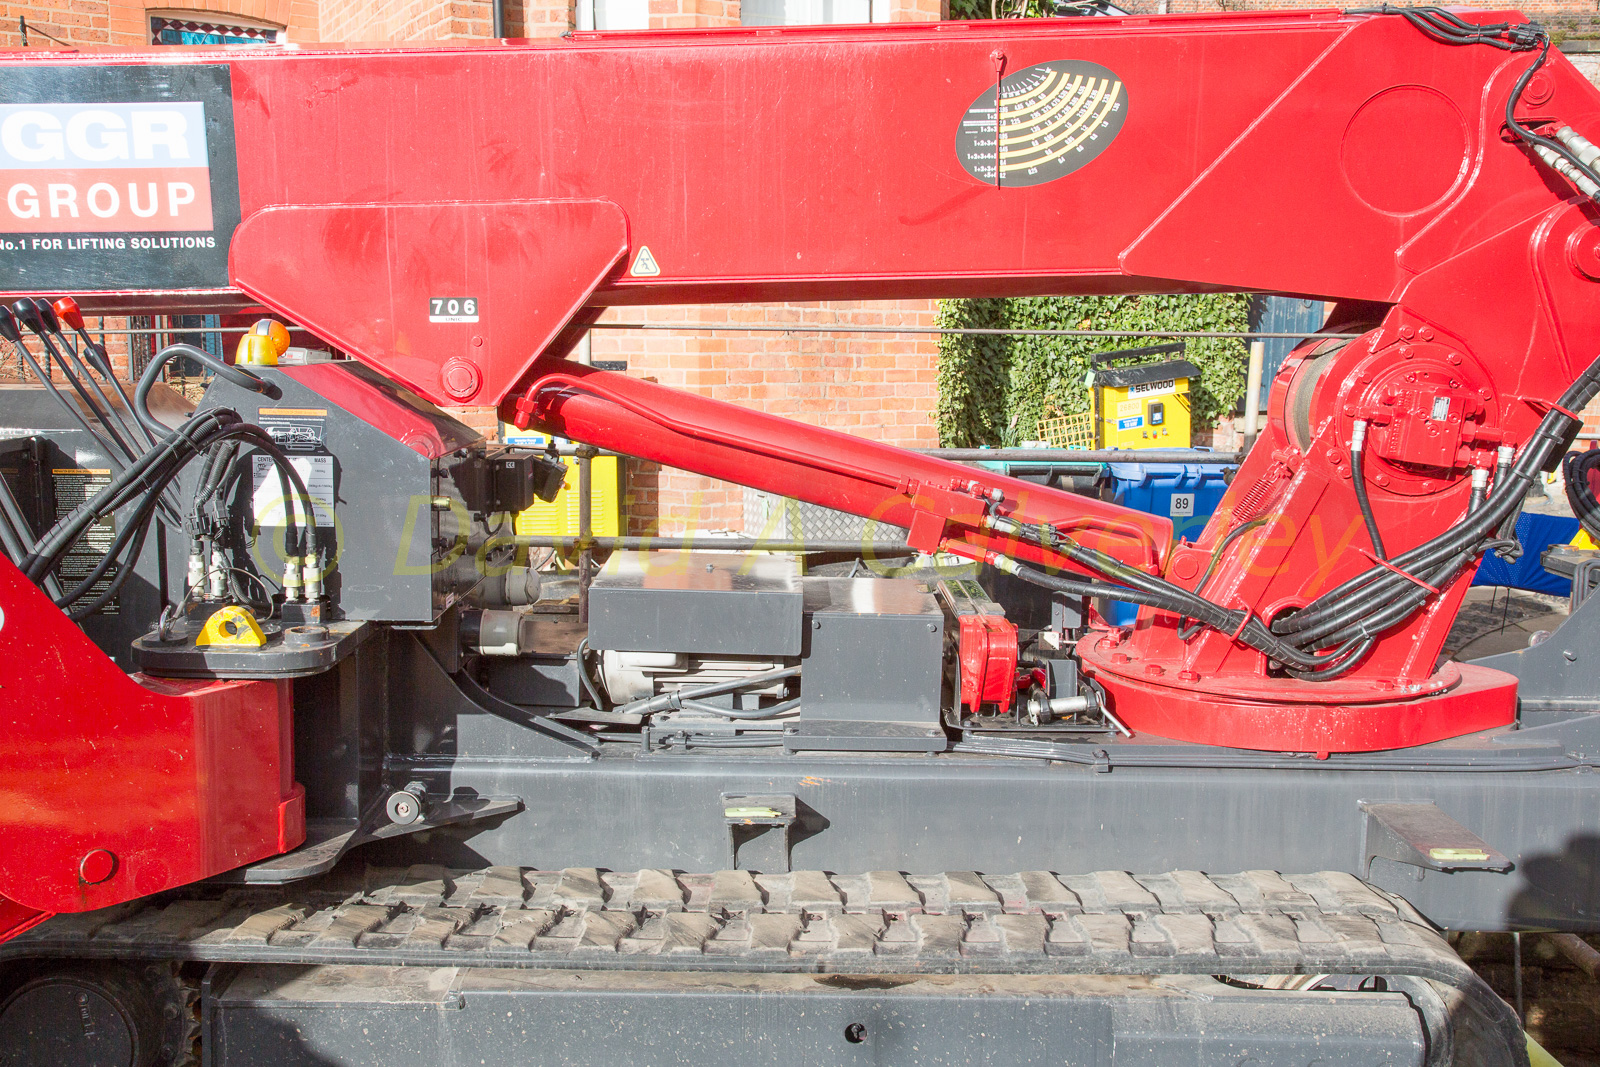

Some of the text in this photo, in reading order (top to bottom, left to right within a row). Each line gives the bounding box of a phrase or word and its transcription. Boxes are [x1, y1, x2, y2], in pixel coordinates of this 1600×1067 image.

[2, 110, 190, 162] GGR
[7, 182, 195, 219] GROUP
[32, 238, 62, 250] FOR
[68, 238, 126, 250] LIFTING
[130, 237, 216, 249] SOLUTIONS
[432, 299, 475, 315] 706
[1136, 380, 1174, 393] SELWOOD
[1175, 498, 1188, 509] 89
